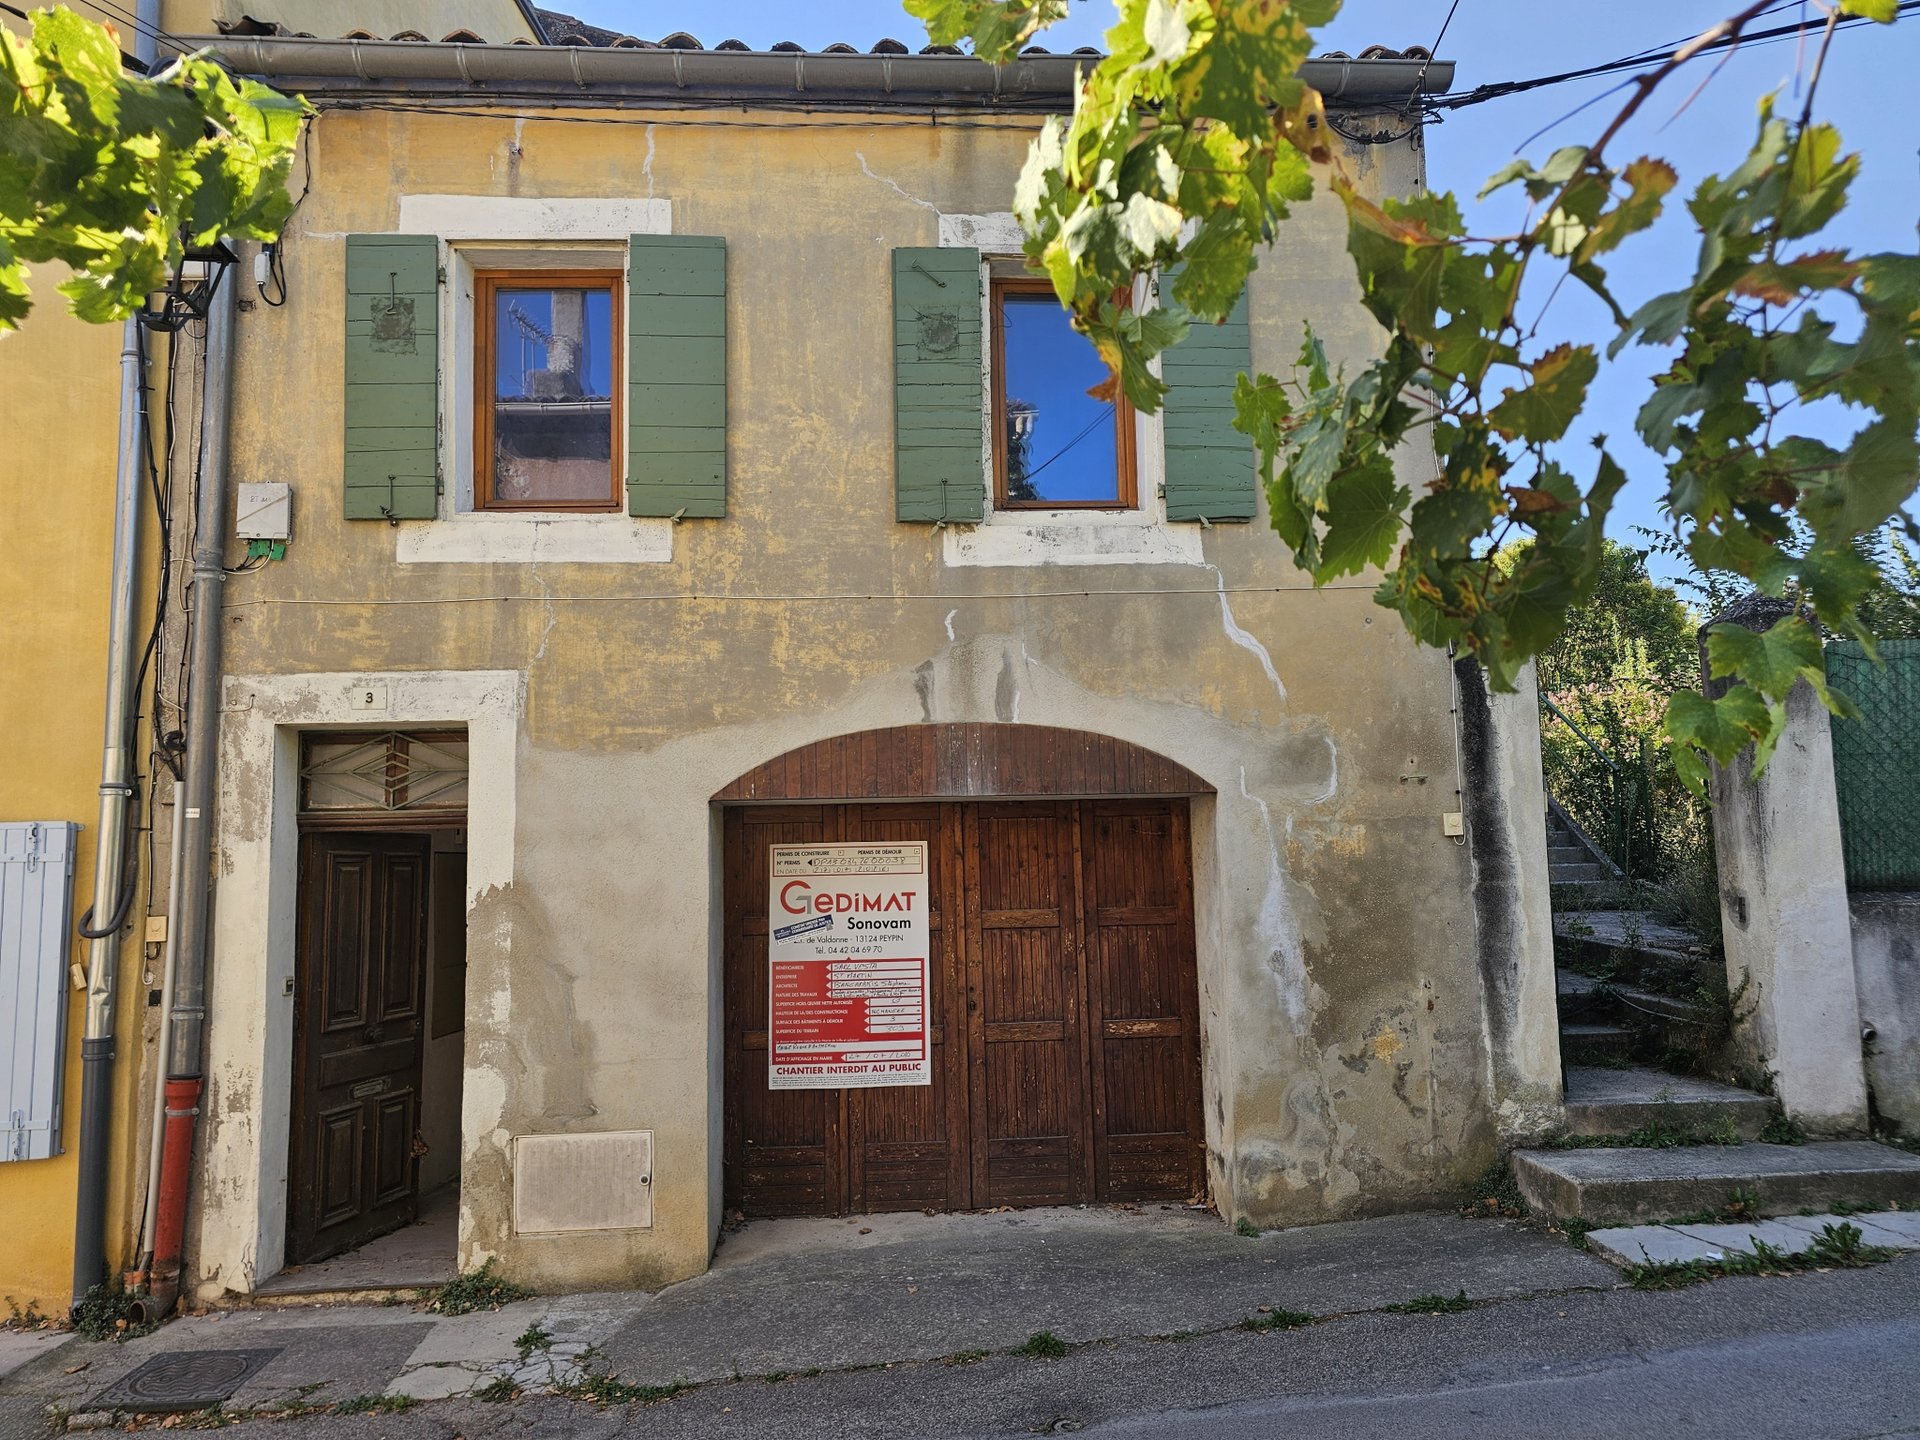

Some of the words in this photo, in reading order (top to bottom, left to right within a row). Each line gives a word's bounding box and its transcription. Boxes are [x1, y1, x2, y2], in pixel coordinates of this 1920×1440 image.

[366, 692, 373, 703] 3
[847, 917, 911, 930] Sonovam
[817, 935, 848, 943] Valdonne
[777, 1066, 823, 1075] CHANTIER
[827, 1065, 869, 1074] INTERDIT
[889, 1063, 921, 1071] PUBLIC
